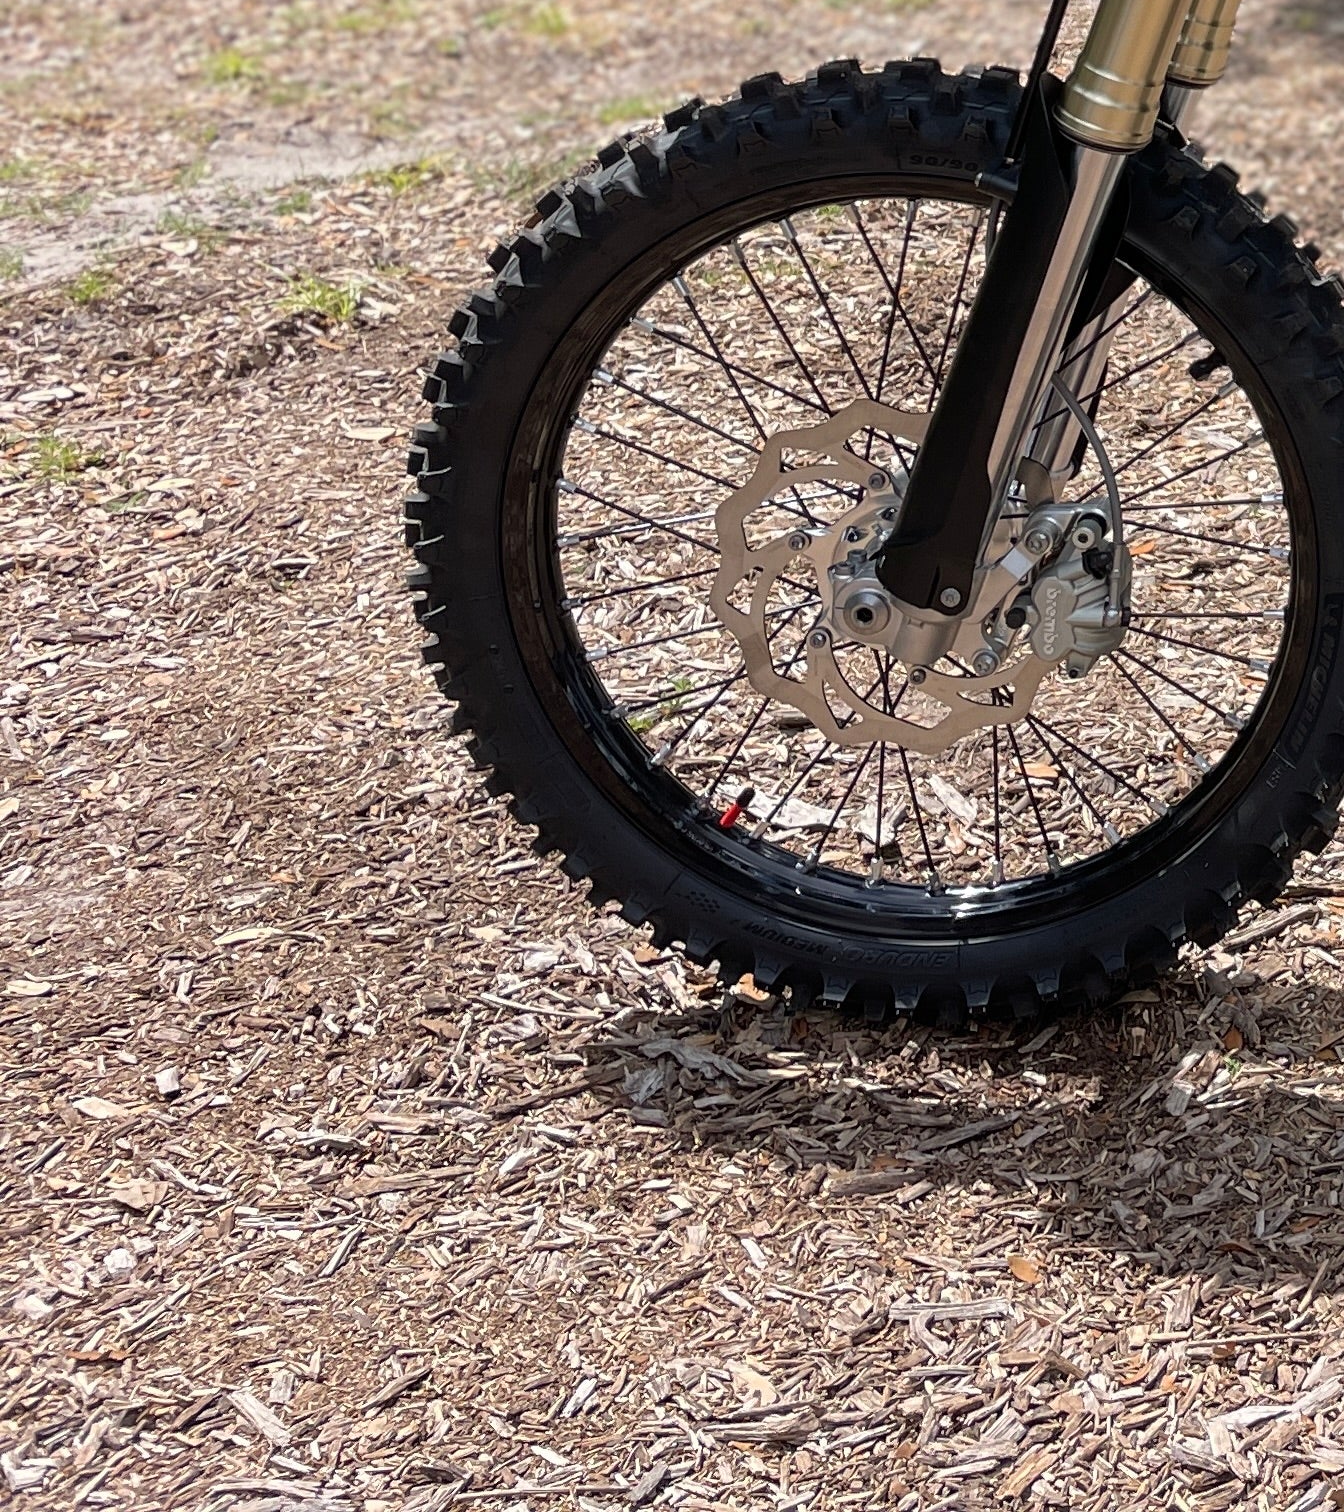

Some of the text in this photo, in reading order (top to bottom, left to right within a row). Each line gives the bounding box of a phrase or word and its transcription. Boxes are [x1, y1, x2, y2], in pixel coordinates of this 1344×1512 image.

[1043, 587, 1062, 656] brembo
[1289, 632, 1336, 753] MICHELIN
[743, 922, 953, 970] ENDURO MEDIUM
